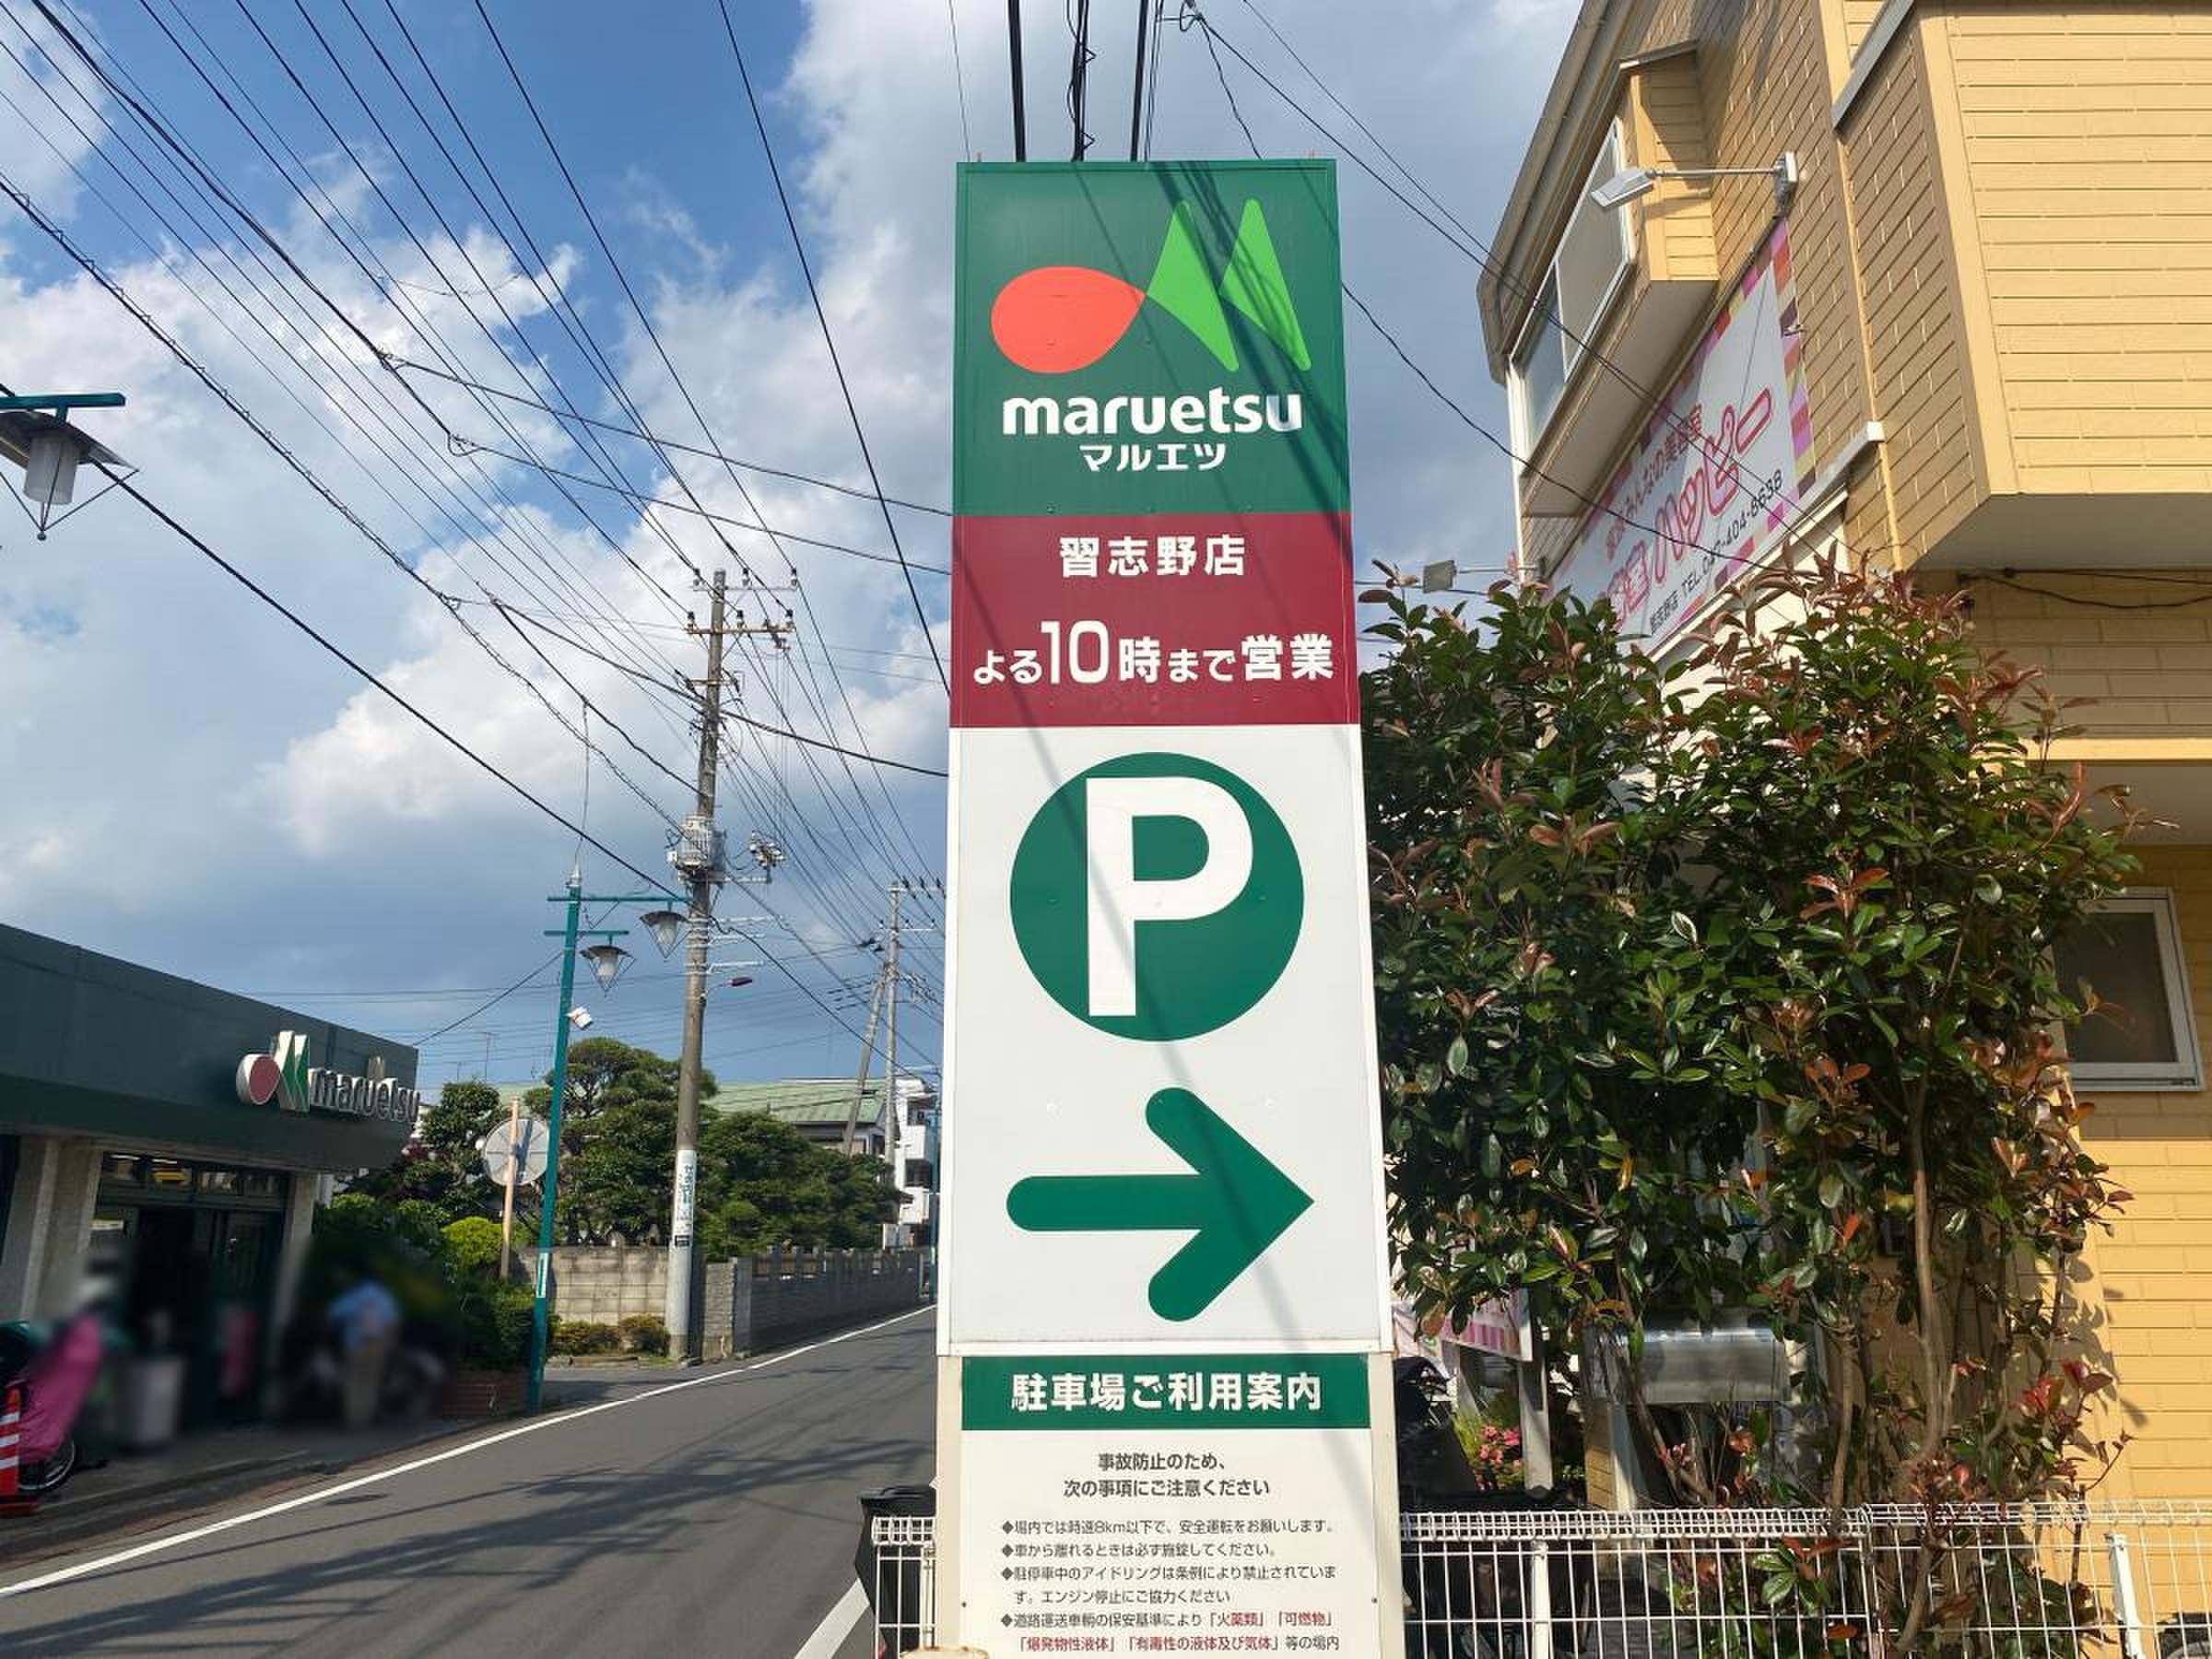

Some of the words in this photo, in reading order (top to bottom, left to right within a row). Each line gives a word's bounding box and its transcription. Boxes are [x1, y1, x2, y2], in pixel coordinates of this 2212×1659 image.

[1002, 386, 1302, 435] maruetsu
[1079, 443, 1226, 472] マルエツ
[1060, 535, 1245, 578] 習志野店
[973, 620, 1334, 684] よる10時まで営業
[1086, 776, 1253, 1017] P
[308, 1067, 420, 1122] maruetsu
[1011, 1372, 1321, 1412] 駐車場ご利用案内
[1098, 1453, 1225, 1472] 事故防止のため、
[1064, 1478, 1270, 1498] 次の事項にご注意ください
